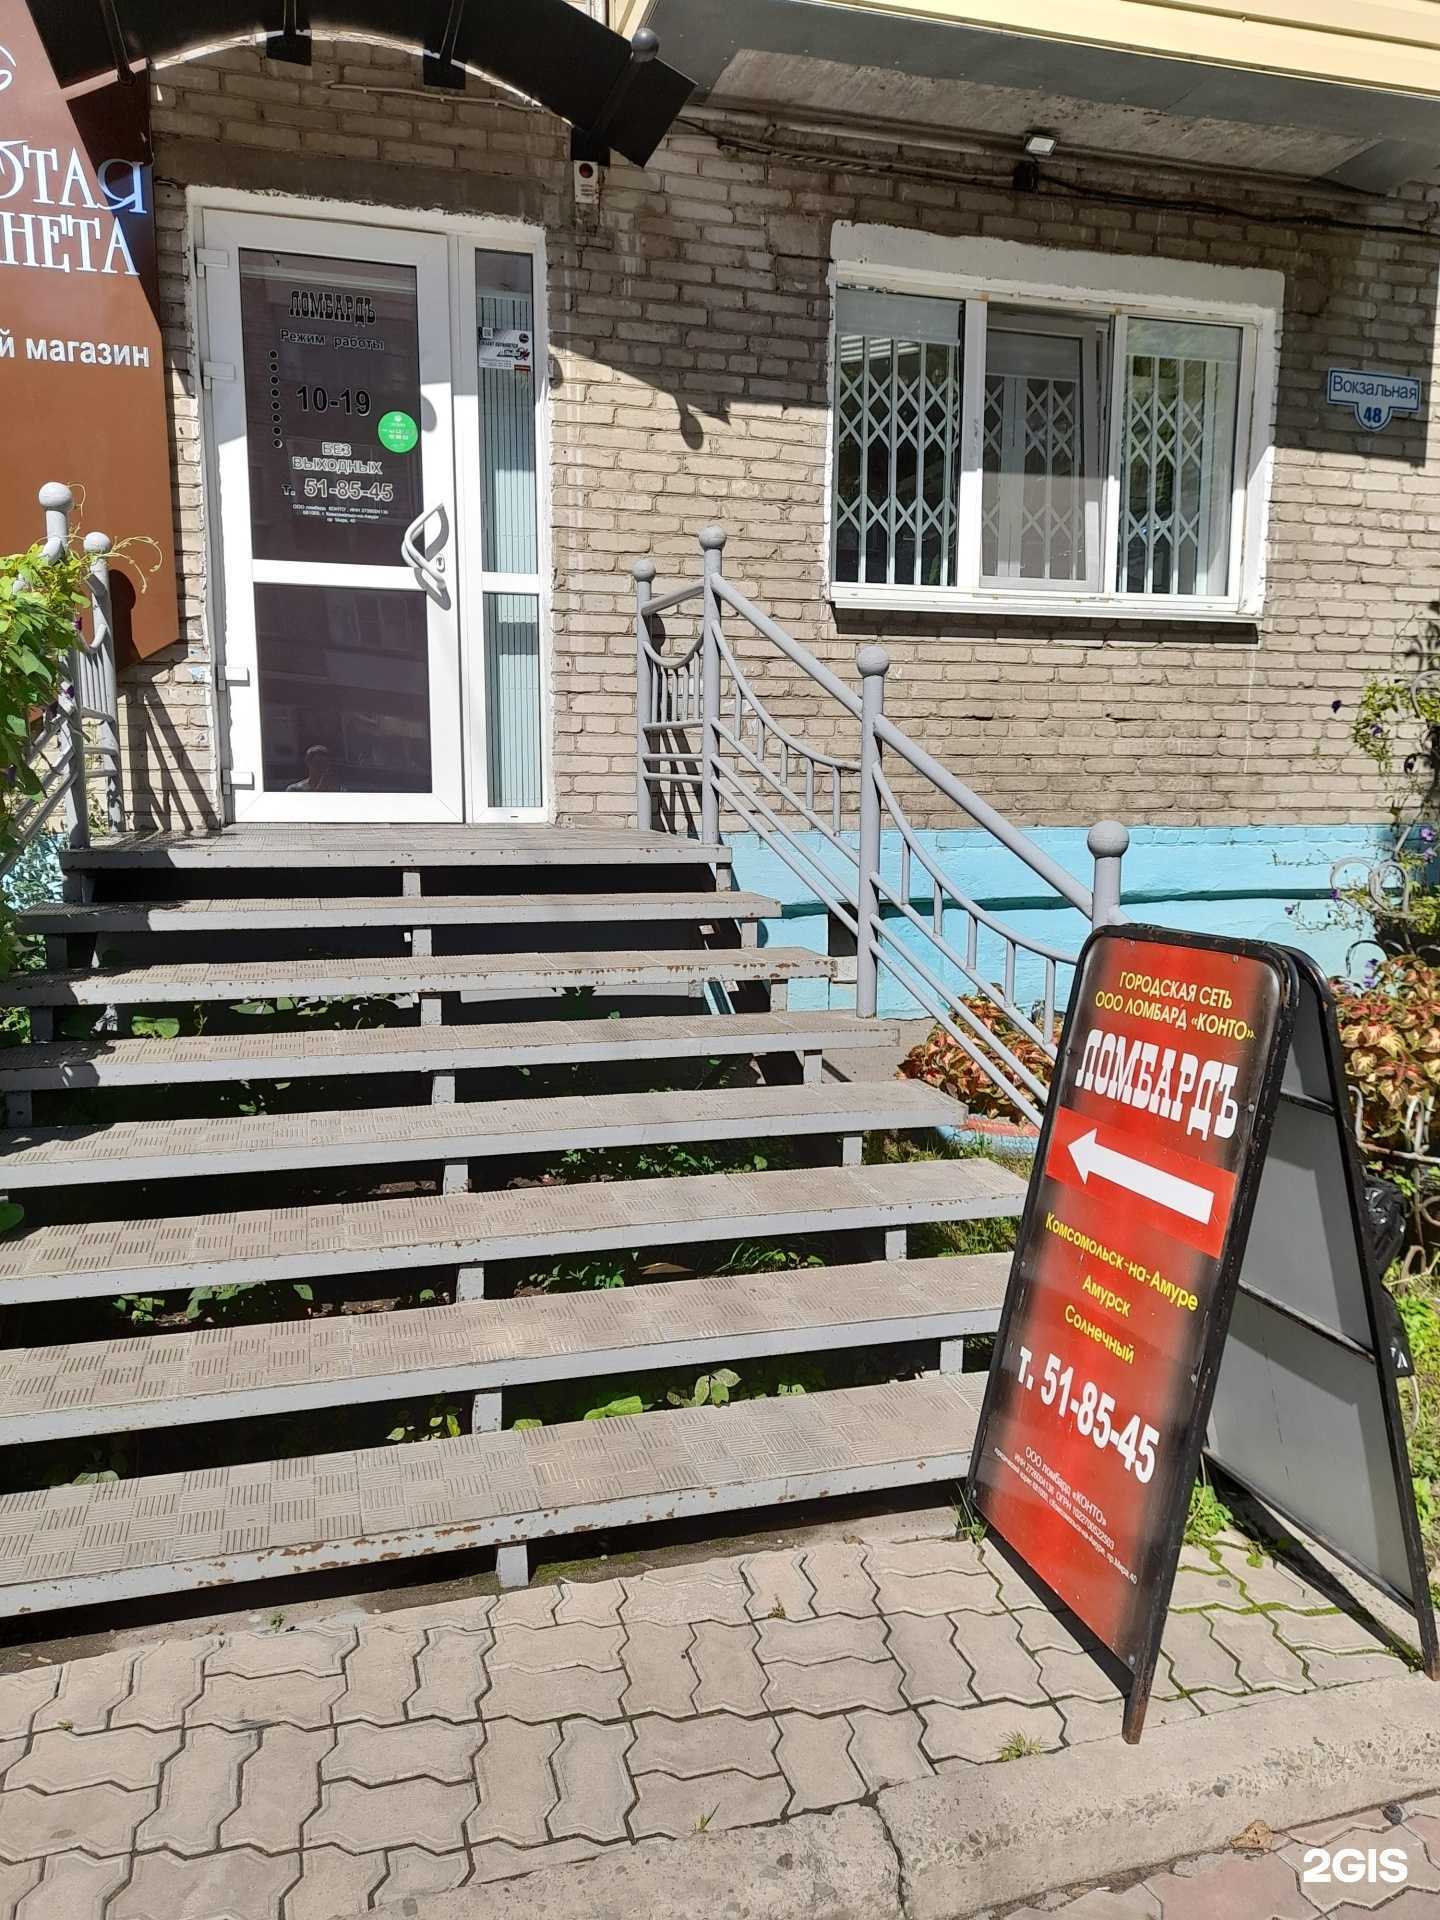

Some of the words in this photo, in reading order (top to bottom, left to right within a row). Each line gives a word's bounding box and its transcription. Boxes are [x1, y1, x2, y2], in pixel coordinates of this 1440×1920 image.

[0, 211, 141, 276] НЕТА
[289, 290, 377, 327] ЛОМБАРДЪ
[25, 337, 150, 368] магазин
[280, 328, 326, 345] Режим
[334, 336, 385, 351] работы
[296, 384, 372, 417] 10-19
[1333, 375, 1417, 400] Вокзальная
[1363, 406, 1382, 424] 48
[291, 456, 384, 475] ВЫХОДНЫХ
[321, 441, 352, 456] БЕЗ
[303, 477, 394, 502] 51-85-45
[1119, 971, 1198, 1002] ГОРОДСКАЯ
[1199, 986, 1233, 1010] СЕТЬ
[1095, 991, 1124, 1011] ООО
[1125, 997, 1188, 1031] ЛОМБАРД
[1191, 1012, 1256, 1042] «КОНТО»
[1074, 1028, 1239, 1142] ЛОМБАРДЪ
[1045, 1212, 1198, 1311] Комсомольск-на-Амуре
[1082, 1275, 1132, 1317] Амурск
[1065, 1304, 1135, 1365] Солнечный
[1040, 1353, 1160, 1484] 51-85-45
[1025, 1446, 1042, 1468] ООО
[1042, 1463, 1072, 1498] ломбард
